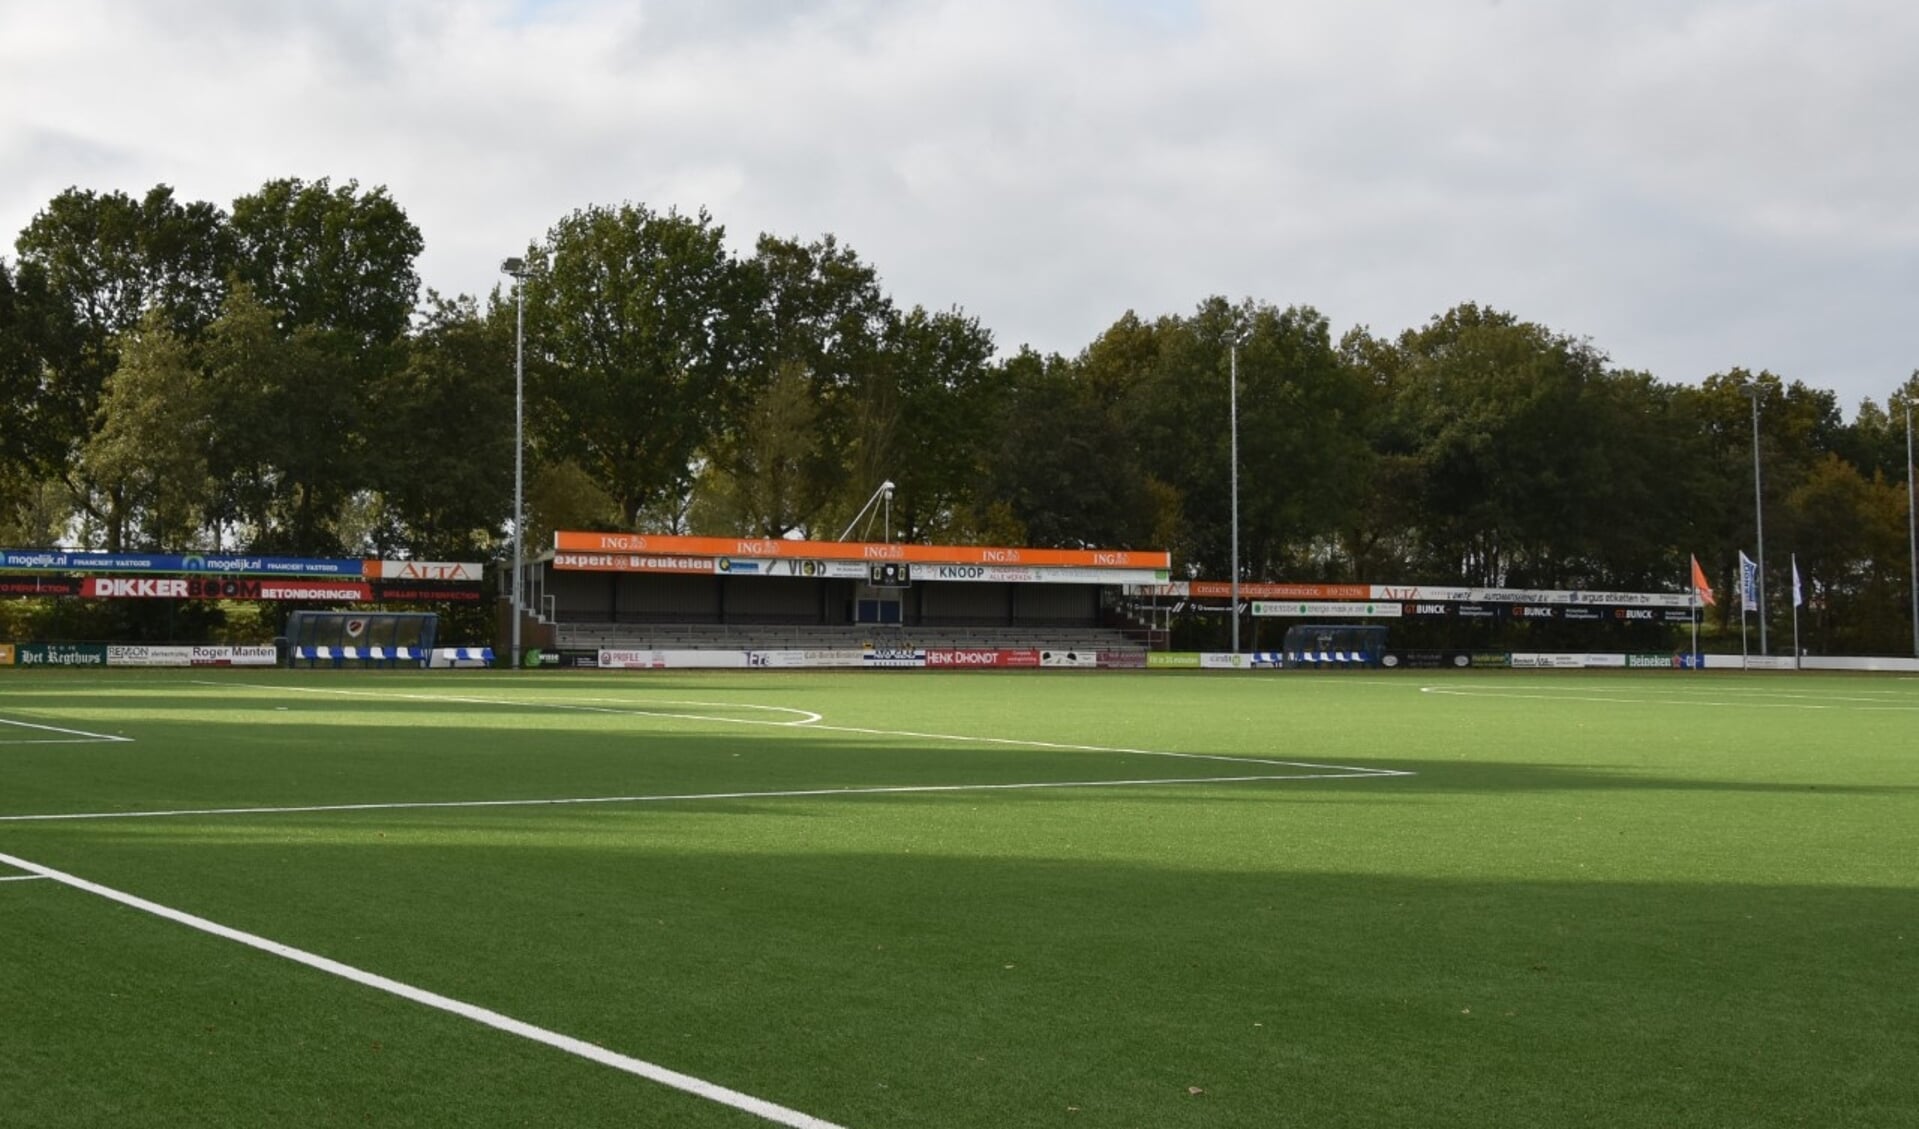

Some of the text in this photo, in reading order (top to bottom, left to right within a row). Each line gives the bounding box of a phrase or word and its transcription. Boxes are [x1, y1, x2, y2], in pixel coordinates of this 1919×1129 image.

[601, 537, 628, 549] ING
[737, 542, 762, 554] ING
[864, 546, 888, 558] ING
[983, 550, 1005, 562] ING
[8, 555, 67, 567] mogelijk.nl
[207, 559, 261, 571] mogelijk.nl
[554, 554, 713, 570] expert Breukelen
[1094, 553, 1115, 565] ING
[397, 563, 470, 579] ALTA
[939, 567, 985, 578] KNOOP
[261, 588, 361, 600] BETONBORINGEN
[1380, 586, 1423, 600] ALTA
[22, 651, 101, 665] Het Regthuys
[193, 647, 229, 659] Roger
[231, 647, 275, 657] Manten
[613, 652, 640, 662] PROFILE
[927, 651, 953, 664] HENK
[955, 651, 999, 664] DHONDT
[1629, 654, 1672, 667] Heineken
